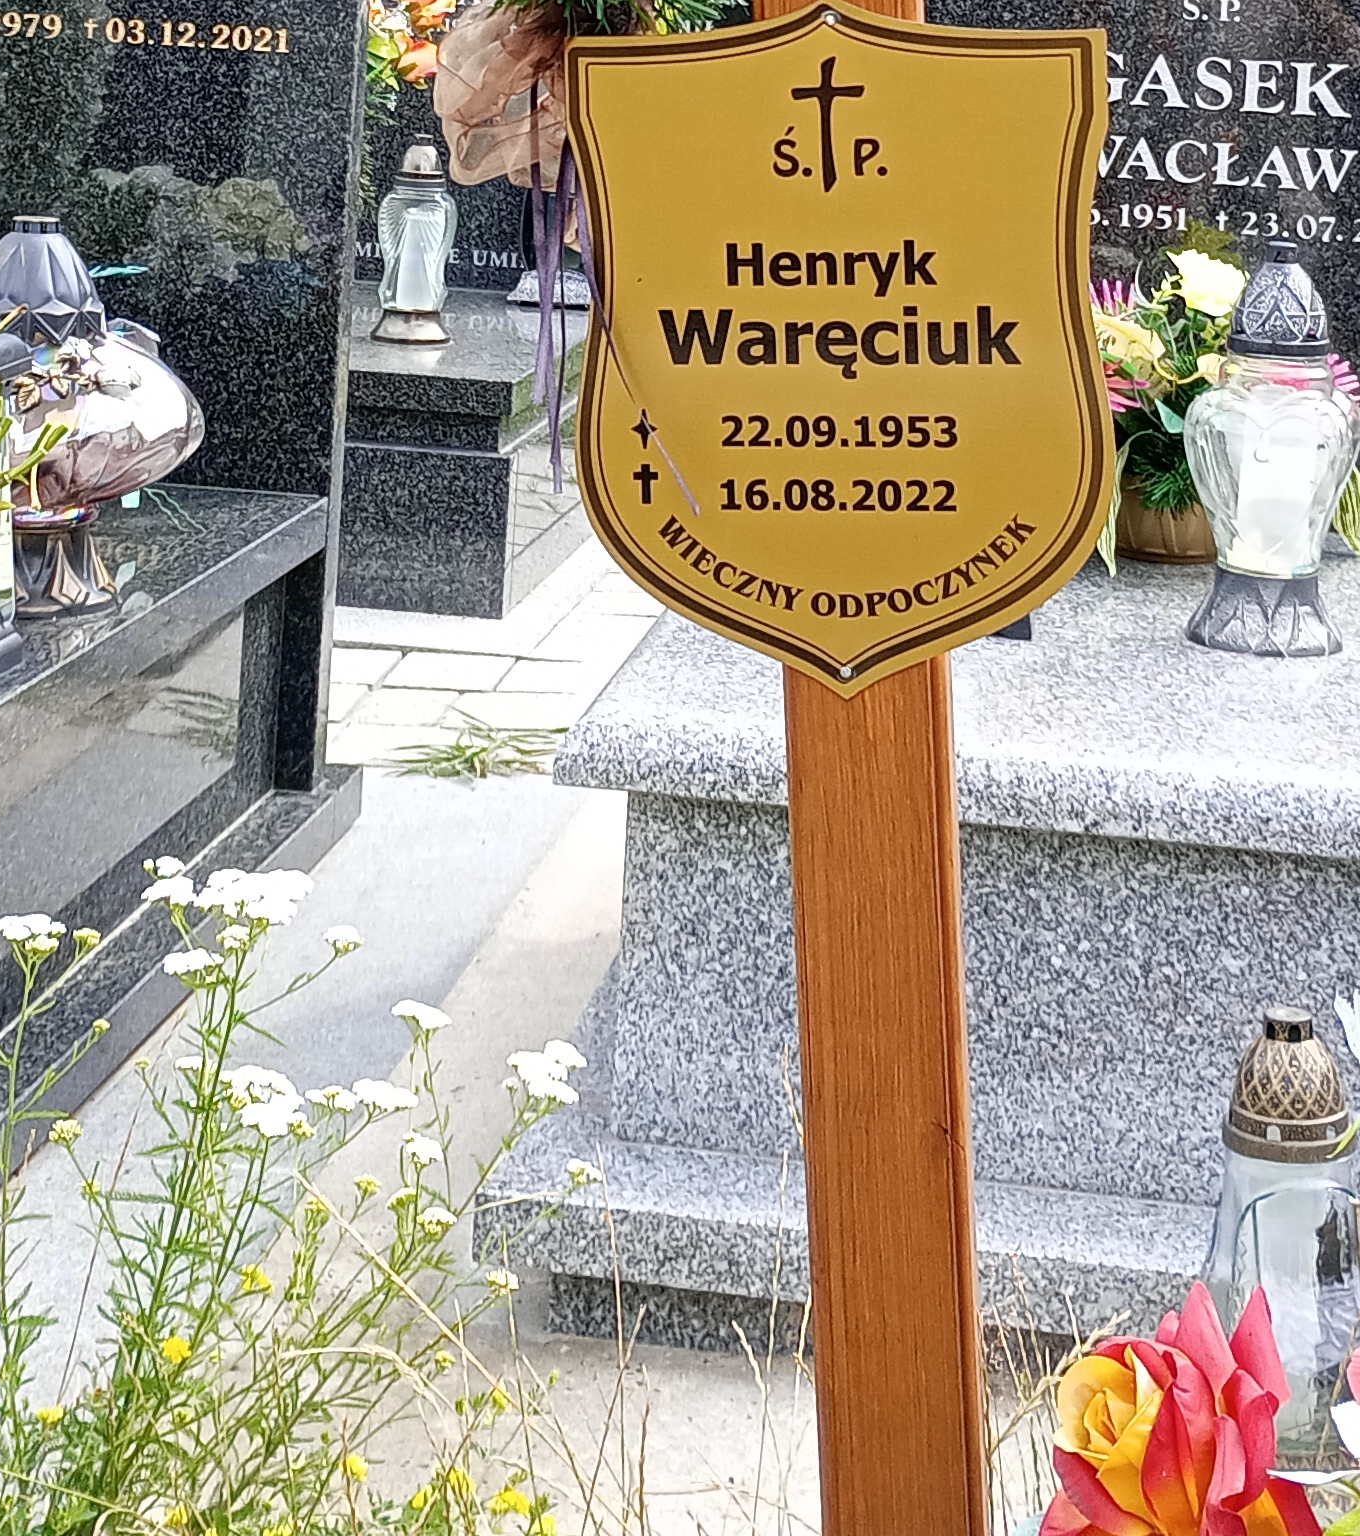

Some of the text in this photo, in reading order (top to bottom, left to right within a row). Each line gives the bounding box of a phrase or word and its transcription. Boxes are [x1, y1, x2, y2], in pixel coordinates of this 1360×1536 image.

[106, 17, 290, 53] 03.12.2021
[725, 239, 938, 296] Henryk
[658, 306, 1022, 380] Waręciuk
[720, 415, 959, 449] 22.09.1953
[720, 478, 958, 513] 16.08.2022
[656, 513, 1038, 619] WIECZNY ODPOCZYNEK
